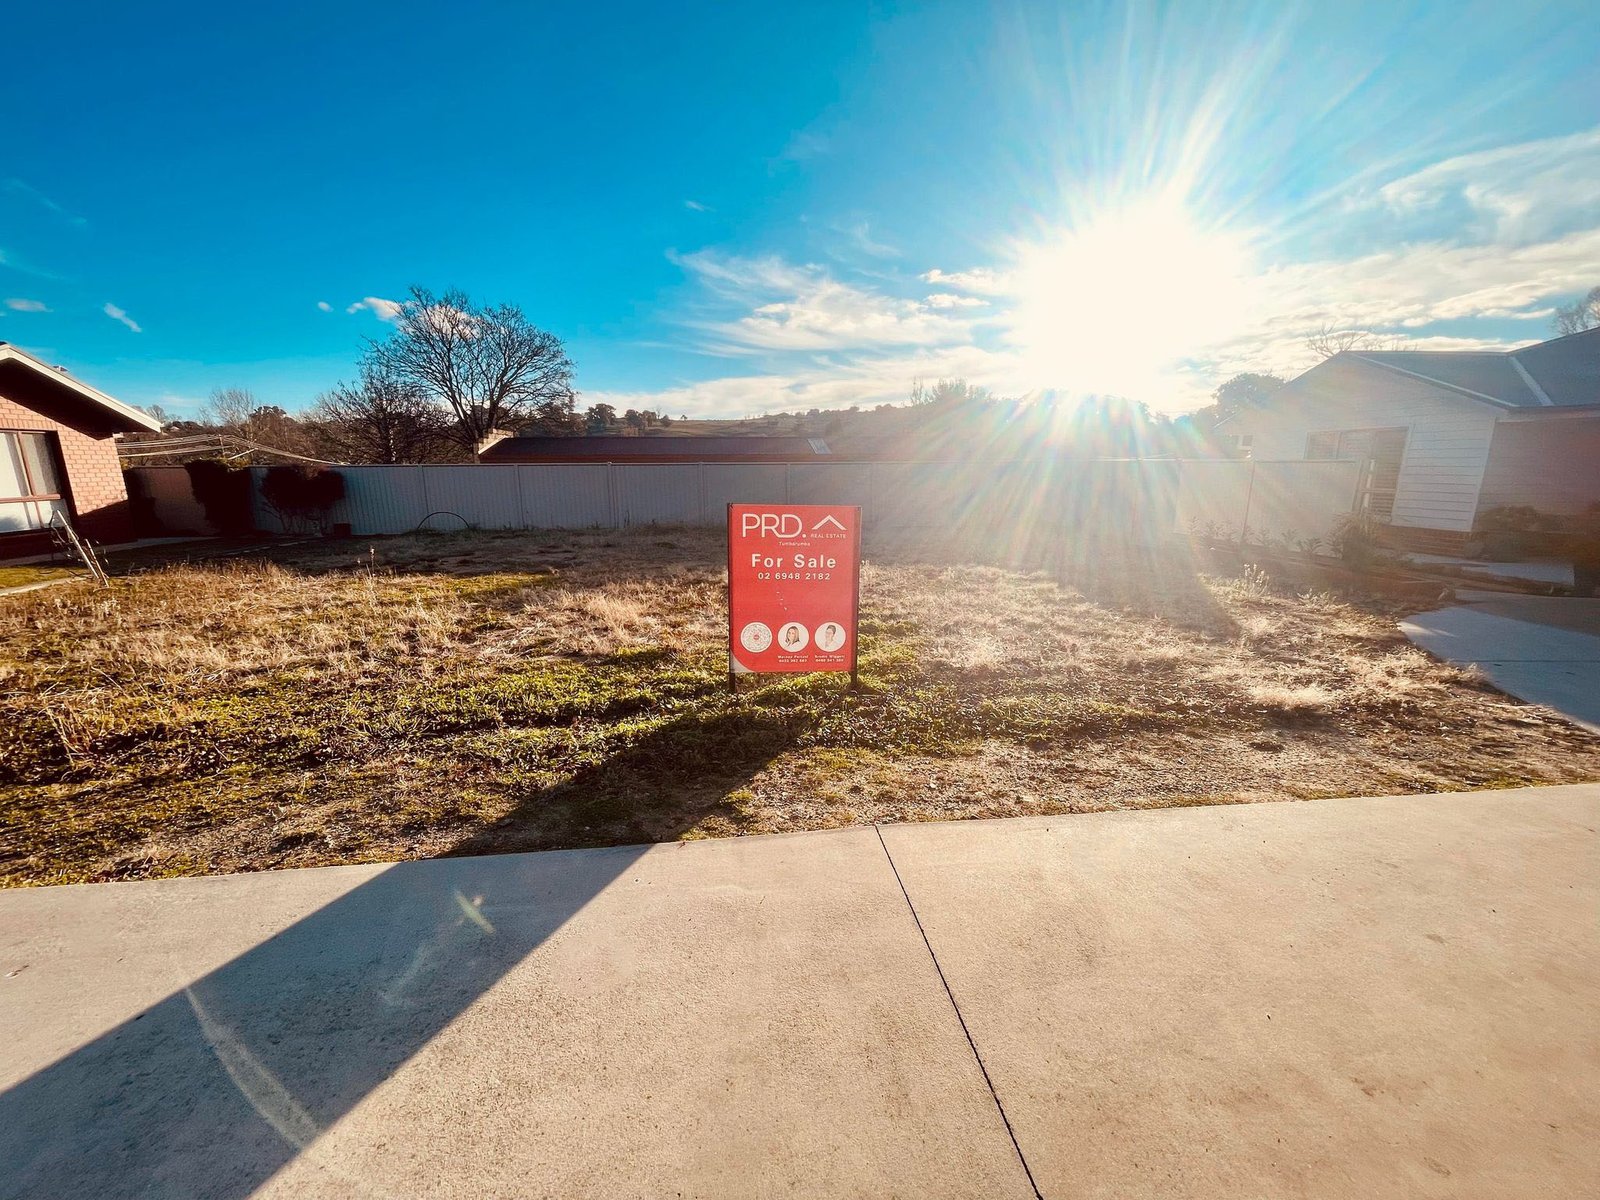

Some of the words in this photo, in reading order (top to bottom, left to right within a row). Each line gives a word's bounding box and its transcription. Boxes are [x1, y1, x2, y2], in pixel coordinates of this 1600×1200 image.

[751, 553, 783, 568] For
[794, 553, 837, 568] Sale
[758, 572, 771, 580] 02
[775, 572, 801, 580] 6948
[805, 572, 831, 580] 2182
